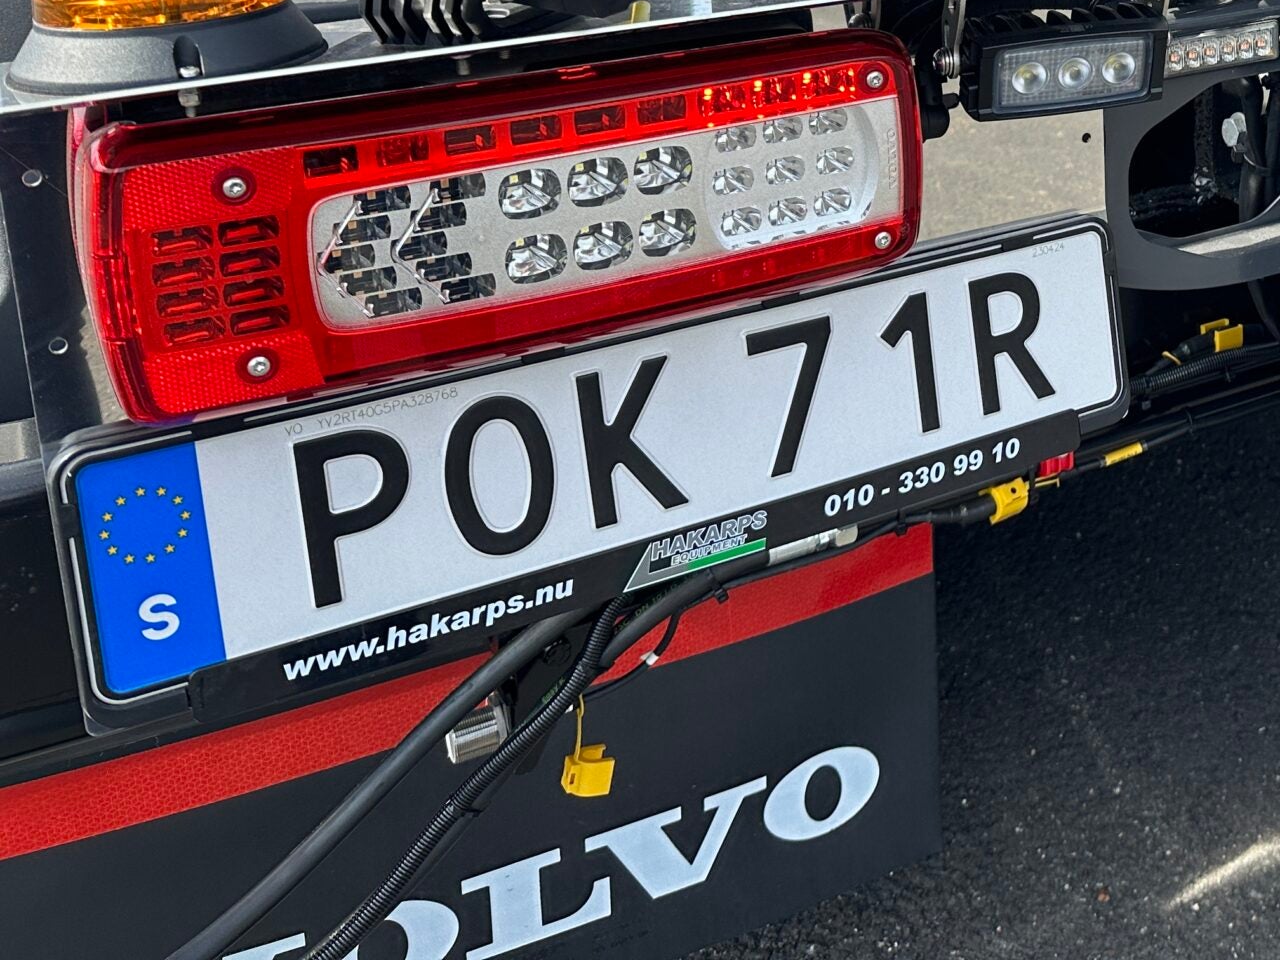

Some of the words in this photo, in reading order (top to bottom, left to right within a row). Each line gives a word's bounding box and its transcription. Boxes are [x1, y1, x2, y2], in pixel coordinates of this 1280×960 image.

[293, 355, 690, 609] POK
[745, 272, 1056, 478] 71R
[824, 464, 875, 518] 010
[898, 461, 946, 494] 330
[953, 449, 984, 477] 99
[991, 437, 1021, 464] 10
[651, 510, 768, 562] HAKARPS
[670, 533, 748, 566] EQUIPMENT
[138, 593, 180, 641] S
[283, 579, 574, 681] www.hakarps.nu
[222, 745, 880, 960] OLVO
